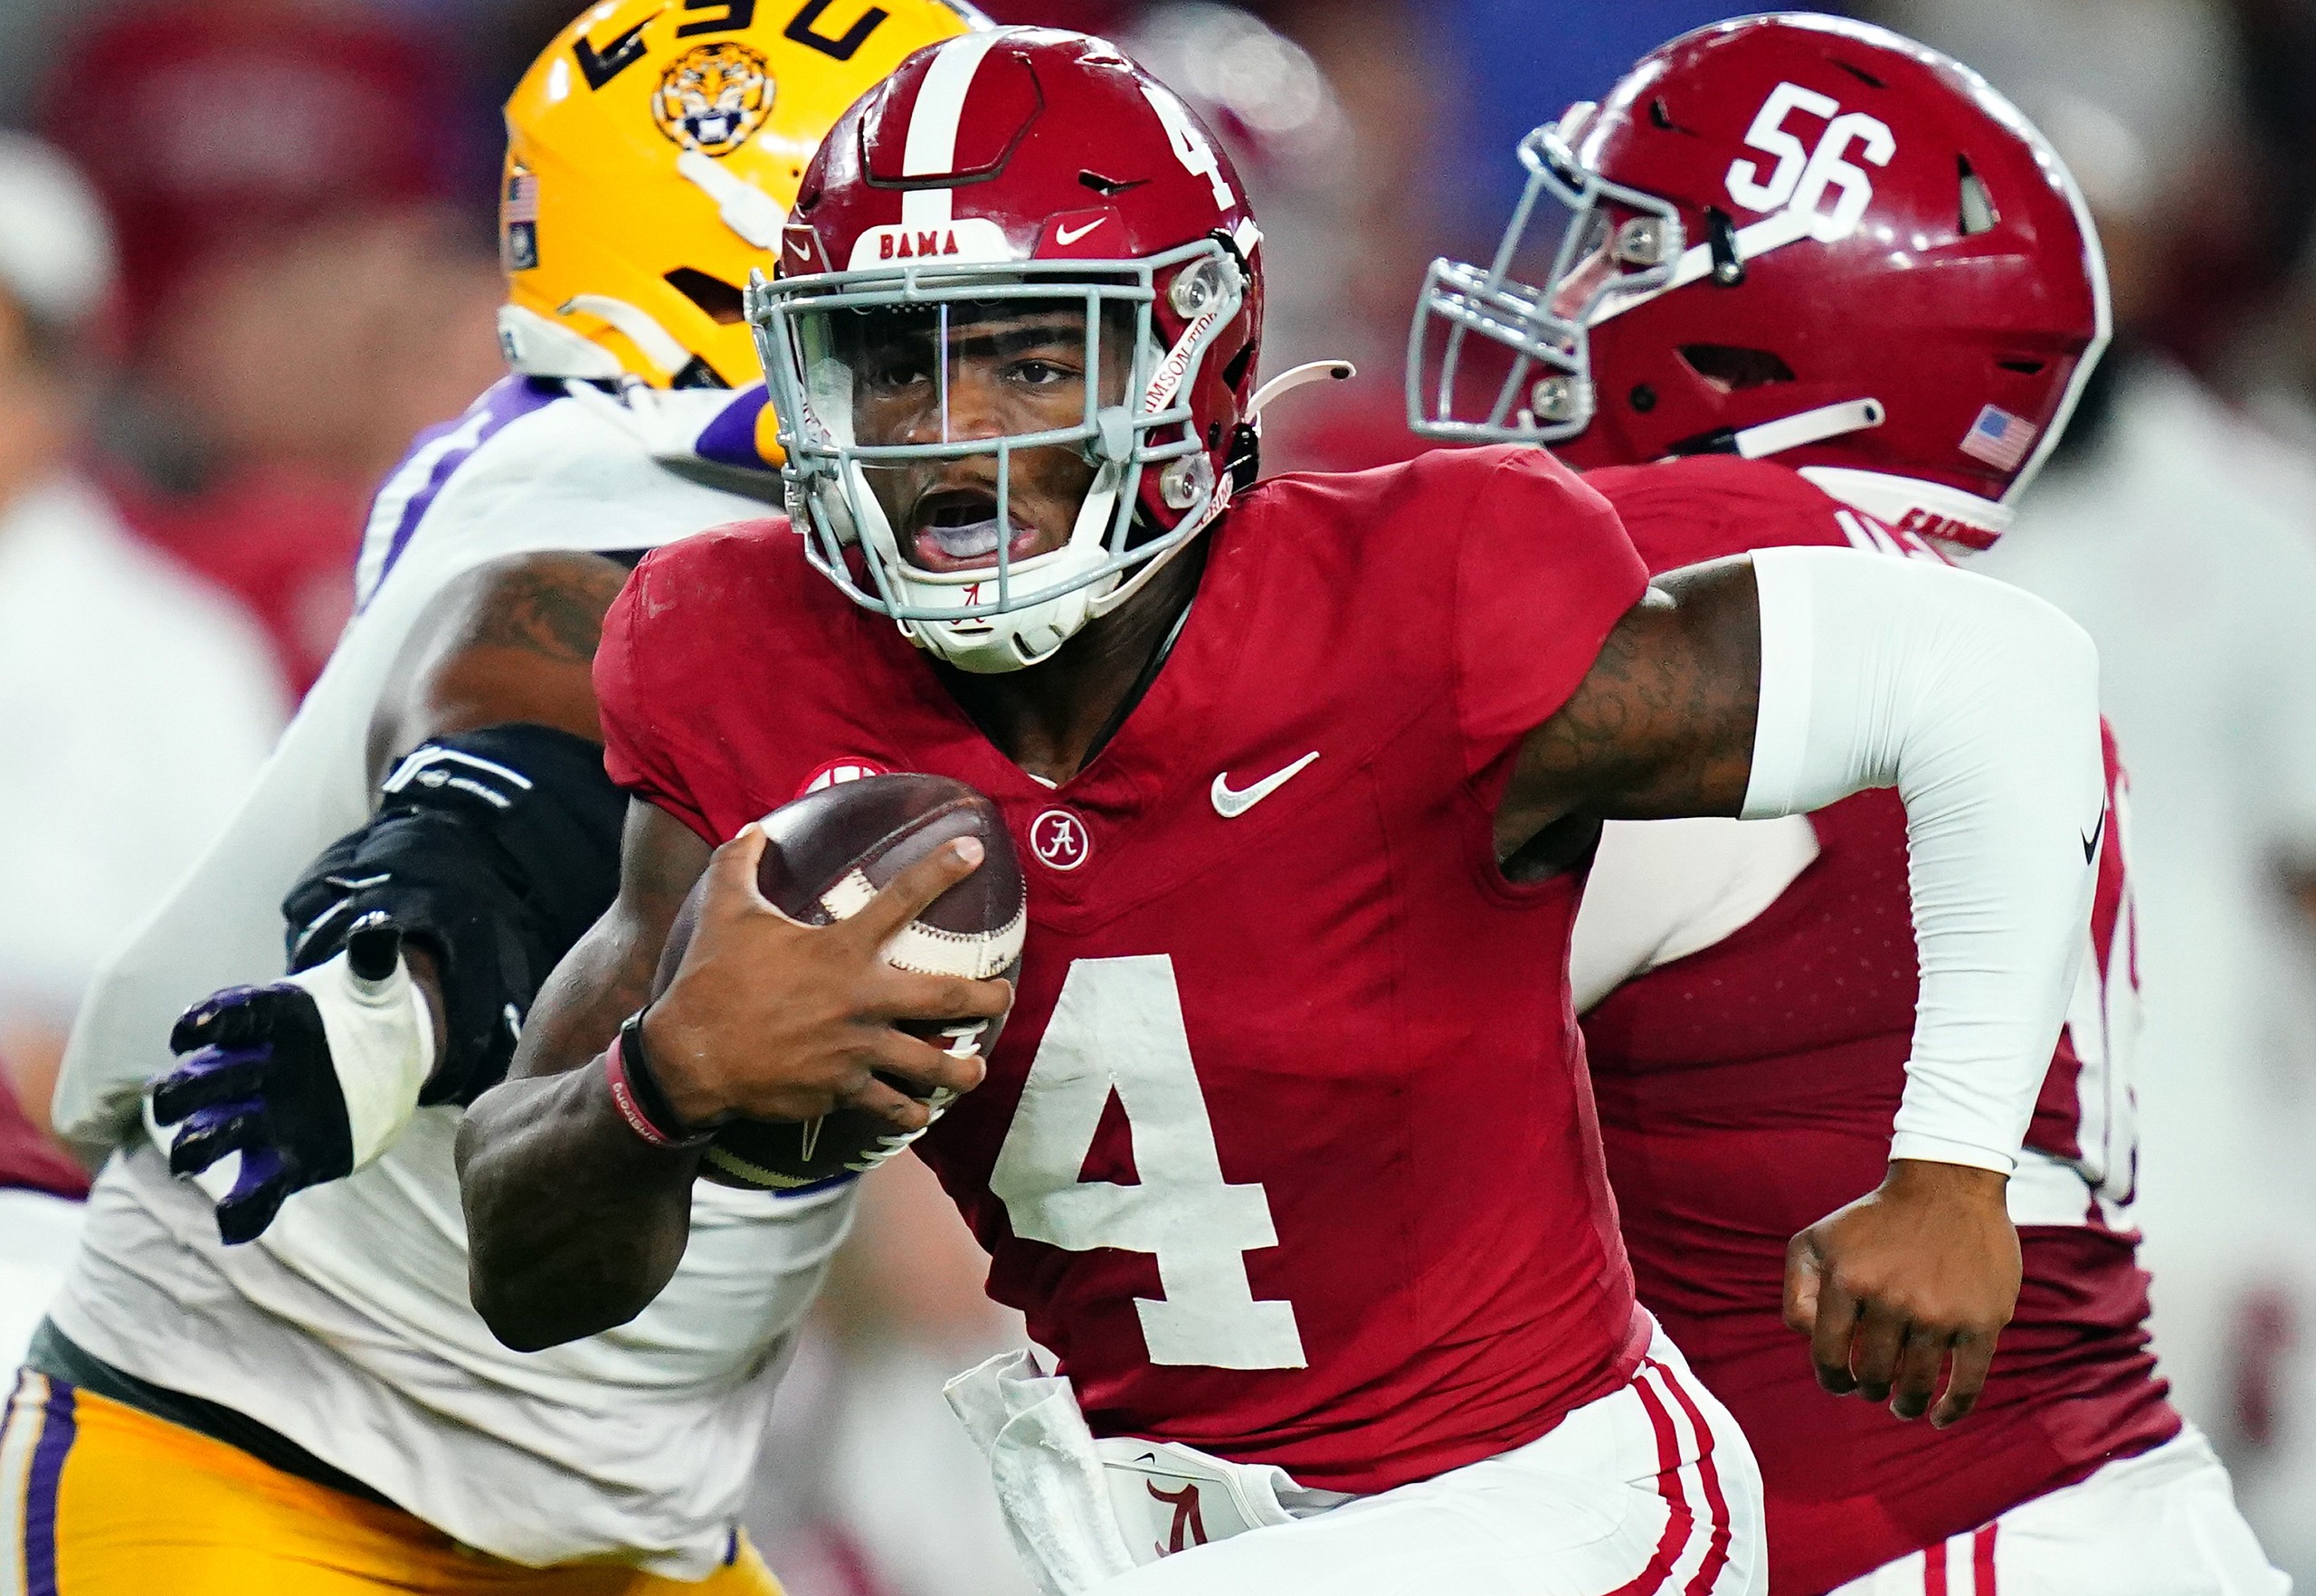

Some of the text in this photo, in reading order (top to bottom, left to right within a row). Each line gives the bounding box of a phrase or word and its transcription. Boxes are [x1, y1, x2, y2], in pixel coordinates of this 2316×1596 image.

[1139, 86, 1237, 212] 4
[1724, 81, 1897, 243] 56
[879, 229, 959, 260] BAMA
[1145, 347, 1191, 413] IMSON
[1040, 820, 1077, 858] A
[990, 953, 1309, 1369] 4
